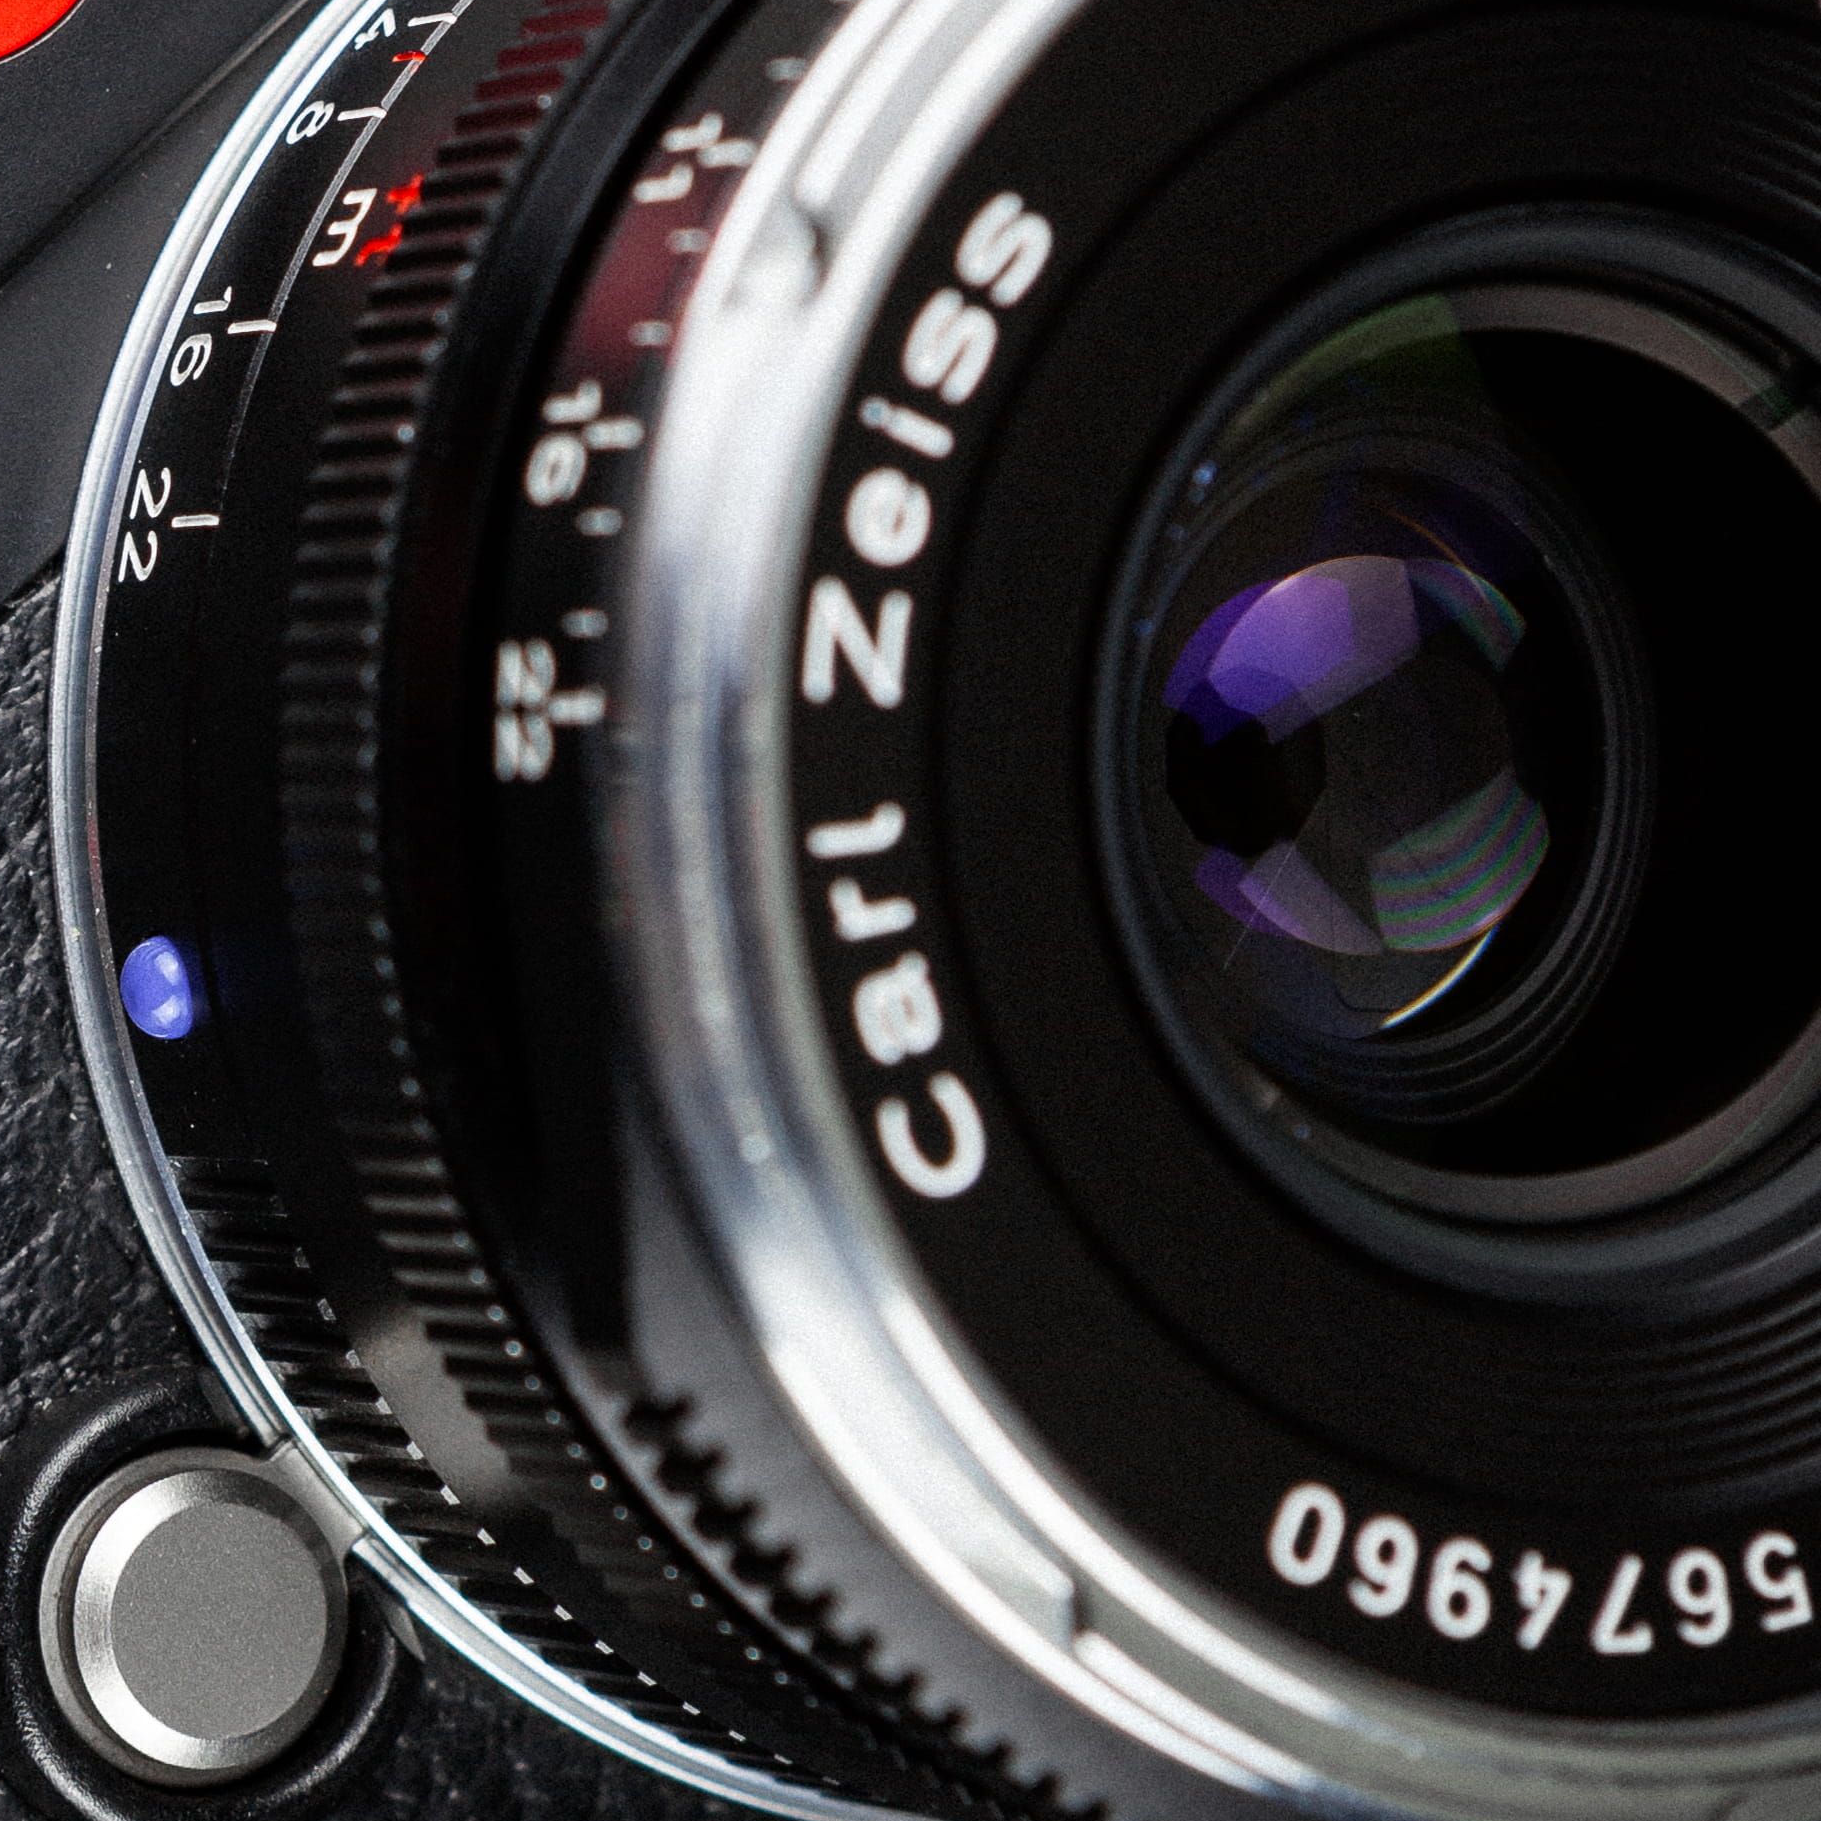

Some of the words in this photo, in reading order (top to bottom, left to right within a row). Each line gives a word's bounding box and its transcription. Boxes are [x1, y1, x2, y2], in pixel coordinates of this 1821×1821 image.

[169, 285, 233, 387] 16
[524, 378, 603, 507] 16
[801, 190, 1055, 709] Zeiss
[116, 466, 173, 584] 22
[493, 636, 558, 782] 22
[806, 801, 988, 1198] Carl
[1267, 1480, 1815, 1656] 5674960
